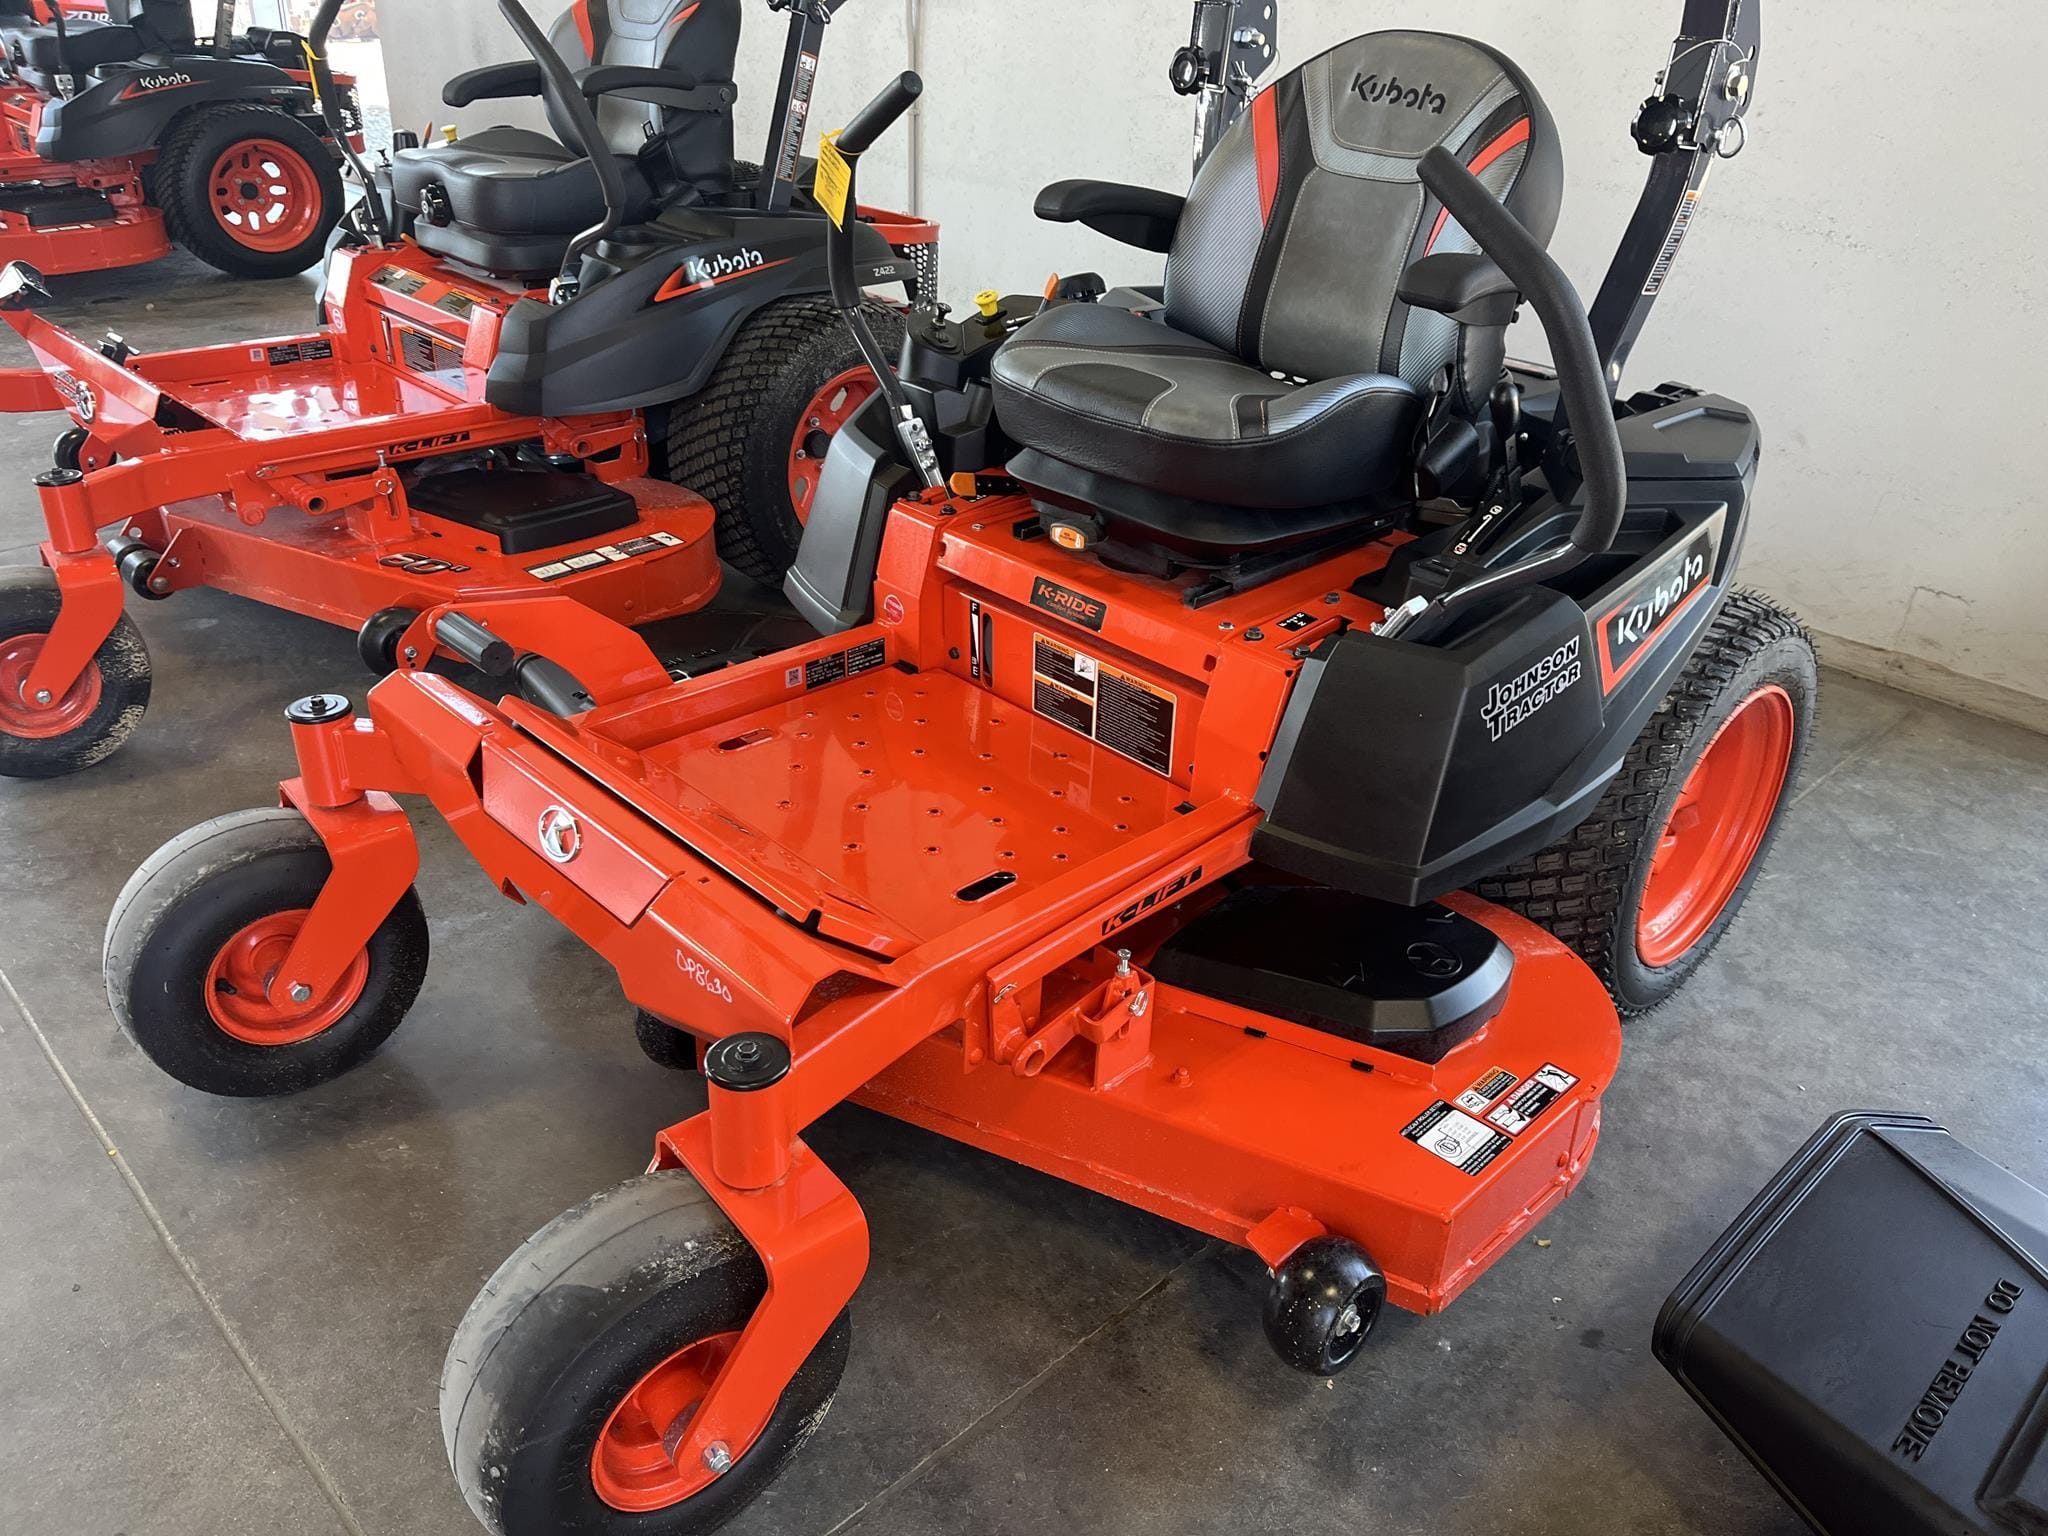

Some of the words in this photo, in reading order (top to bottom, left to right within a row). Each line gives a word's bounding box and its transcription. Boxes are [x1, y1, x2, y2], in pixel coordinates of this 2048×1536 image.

[140, 72, 191, 89] Kubota
[1350, 72, 1446, 114] Kubota
[689, 247, 764, 279] Kubota
[872, 265, 896, 277] Z422
[391, 431, 468, 455] K-LIFT
[1037, 584, 1100, 618] K-RIDE
[1617, 554, 1703, 645] Kubota
[1480, 634, 1580, 720] JOHNSON
[1486, 661, 1582, 743] TRACTOR
[1104, 867, 1201, 934] K-LIFT
[1984, 1277, 2024, 1314] DO
[1953, 1314, 2002, 1366] NOT
[1891, 1358, 1974, 1463] REMOVE
